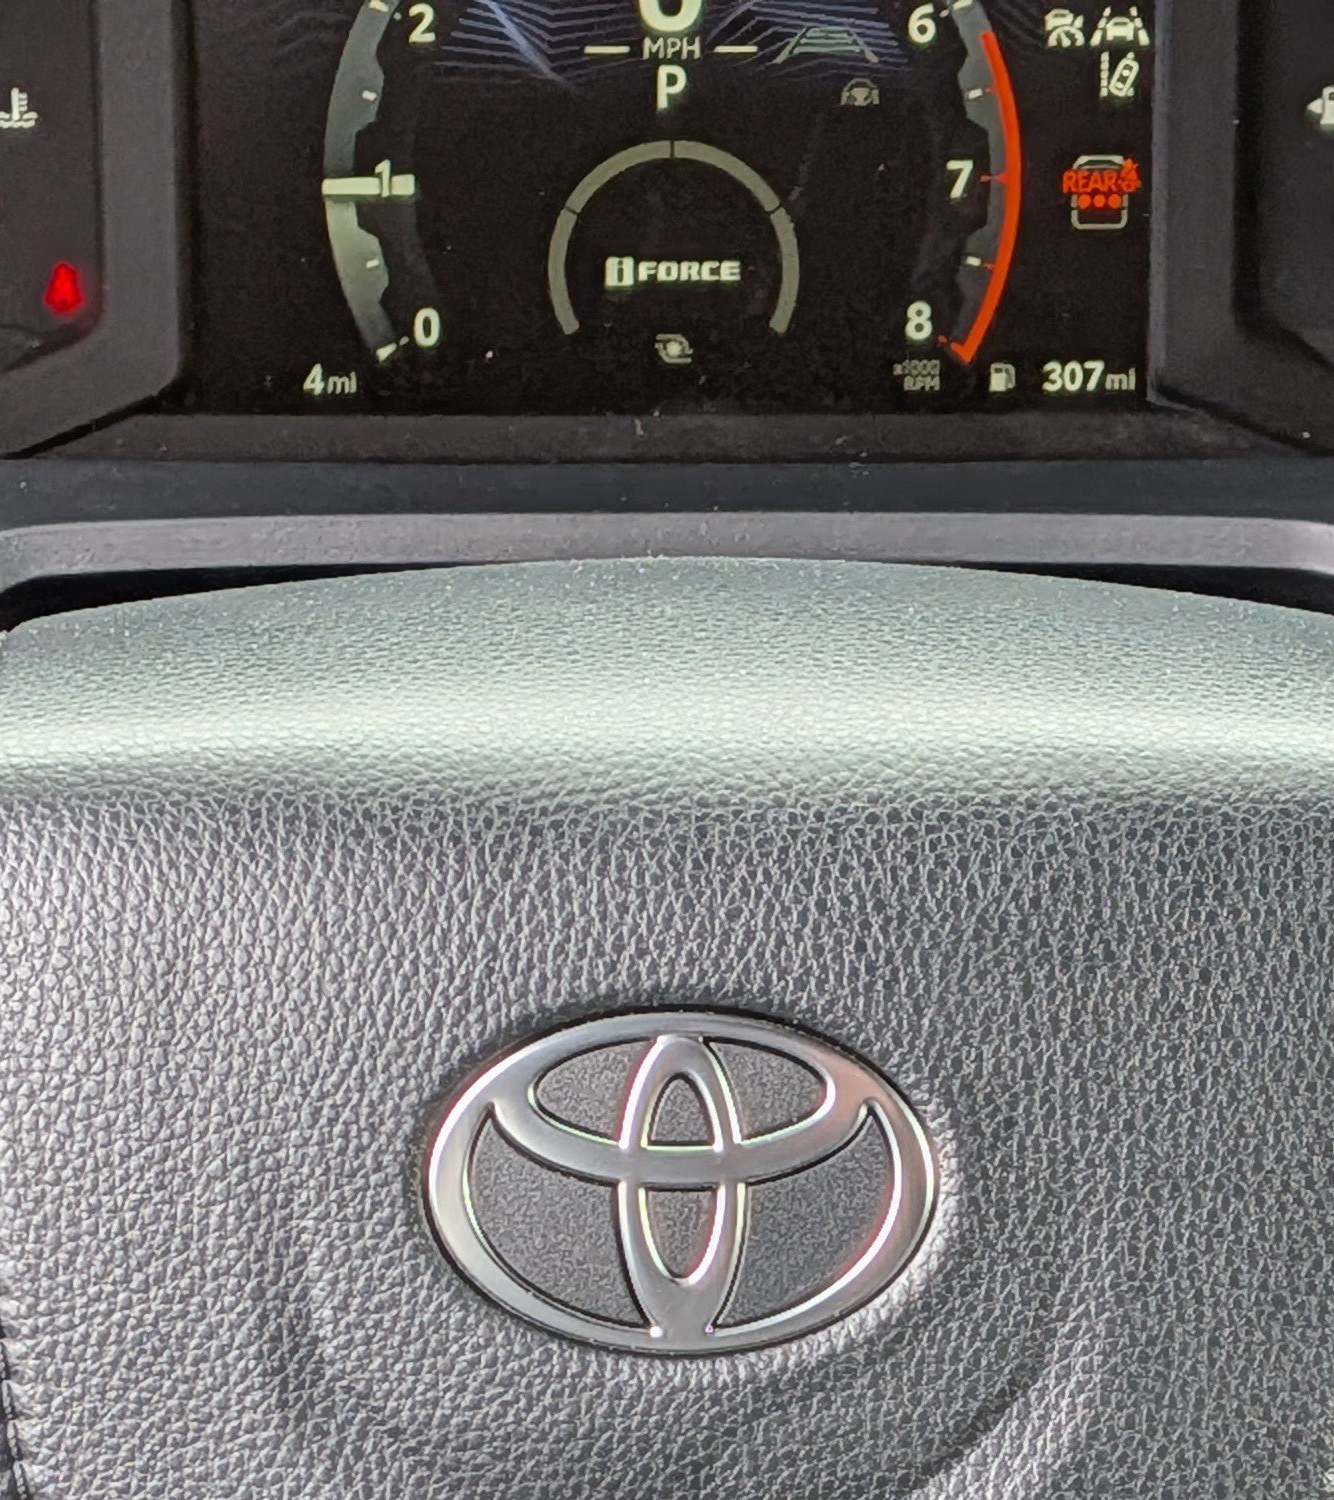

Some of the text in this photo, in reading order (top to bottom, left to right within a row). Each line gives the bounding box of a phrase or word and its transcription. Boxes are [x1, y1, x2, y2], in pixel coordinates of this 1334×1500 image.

[408, 4, 436, 43] 2
[908, 4, 936, 43] 6
[643, 36, 701, 60] MPH
[657, 64, 687, 110] P
[946, 159, 974, 199] 7
[1062, 169, 1118, 194] REAR
[638, 260, 742, 282] FORCE
[413, 308, 441, 348] 0
[906, 301, 933, 341] 8
